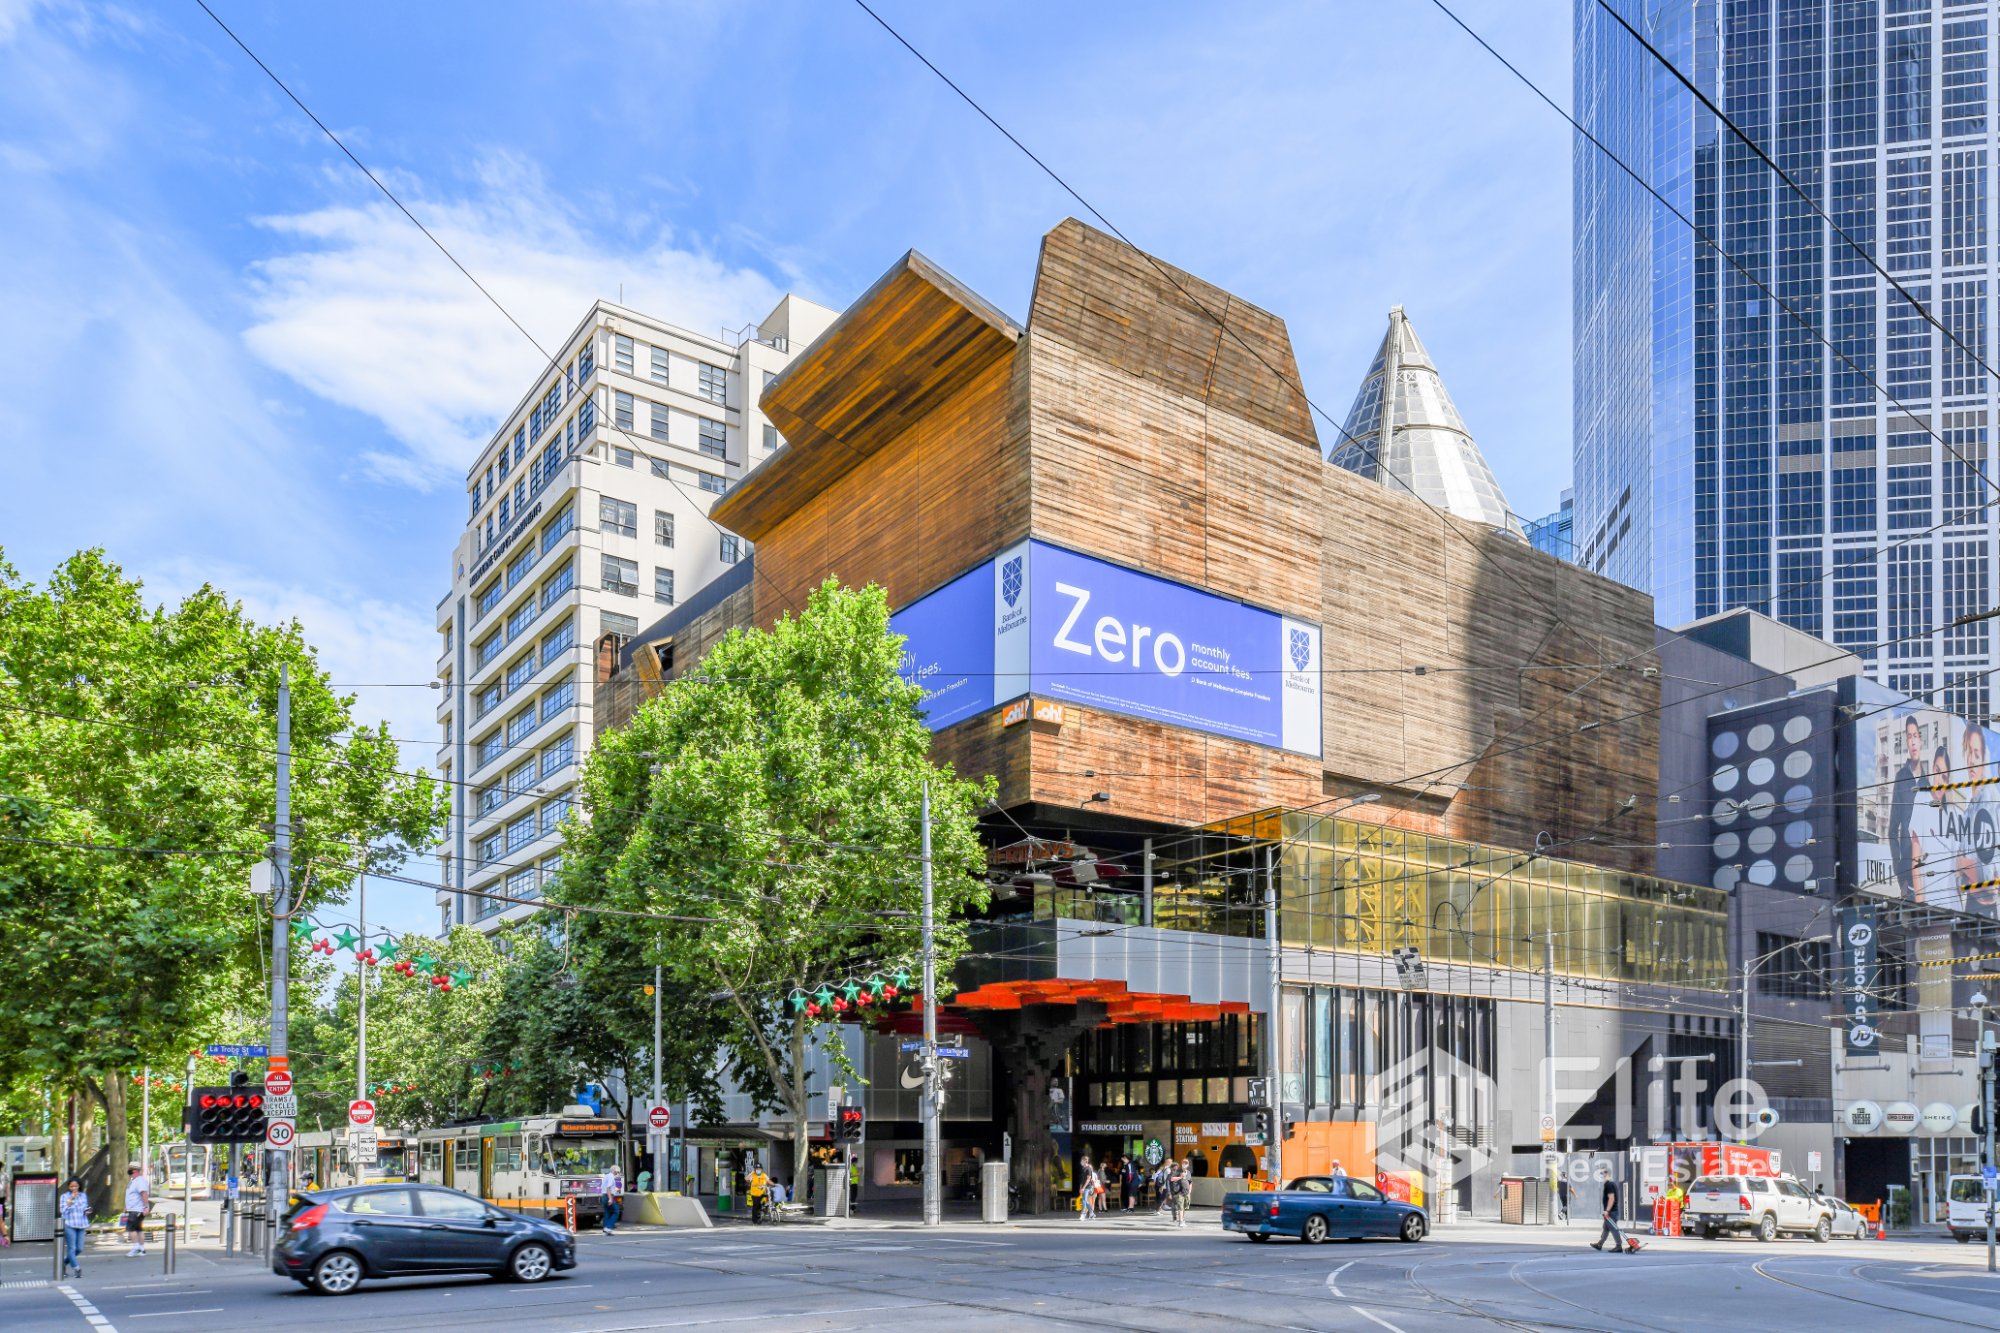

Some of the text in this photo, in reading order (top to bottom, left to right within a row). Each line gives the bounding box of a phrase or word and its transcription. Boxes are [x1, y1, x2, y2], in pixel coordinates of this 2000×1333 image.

[1002, 606, 1023, 623] Bank of
[997, 615, 1028, 636] Melbourne
[1053, 581, 1186, 677] Zero
[1191, 643, 1231, 663] monthly
[918, 662, 942, 680] fees.
[1191, 657, 1253, 681] account fees.
[1290, 672, 1303, 682] Bank
[946, 678, 968, 692] Freedom
[1285, 680, 1315, 695] Melbourne
[1945, 811, 1971, 845] AM
[1866, 858, 1887, 885] LEVEL
[221, 1046, 240, 1054] Trobe
[272, 1128, 289, 1139] 30
[1175, 1127, 1192, 1135] SEOUL
[1175, 1135, 1198, 1143] STATION
